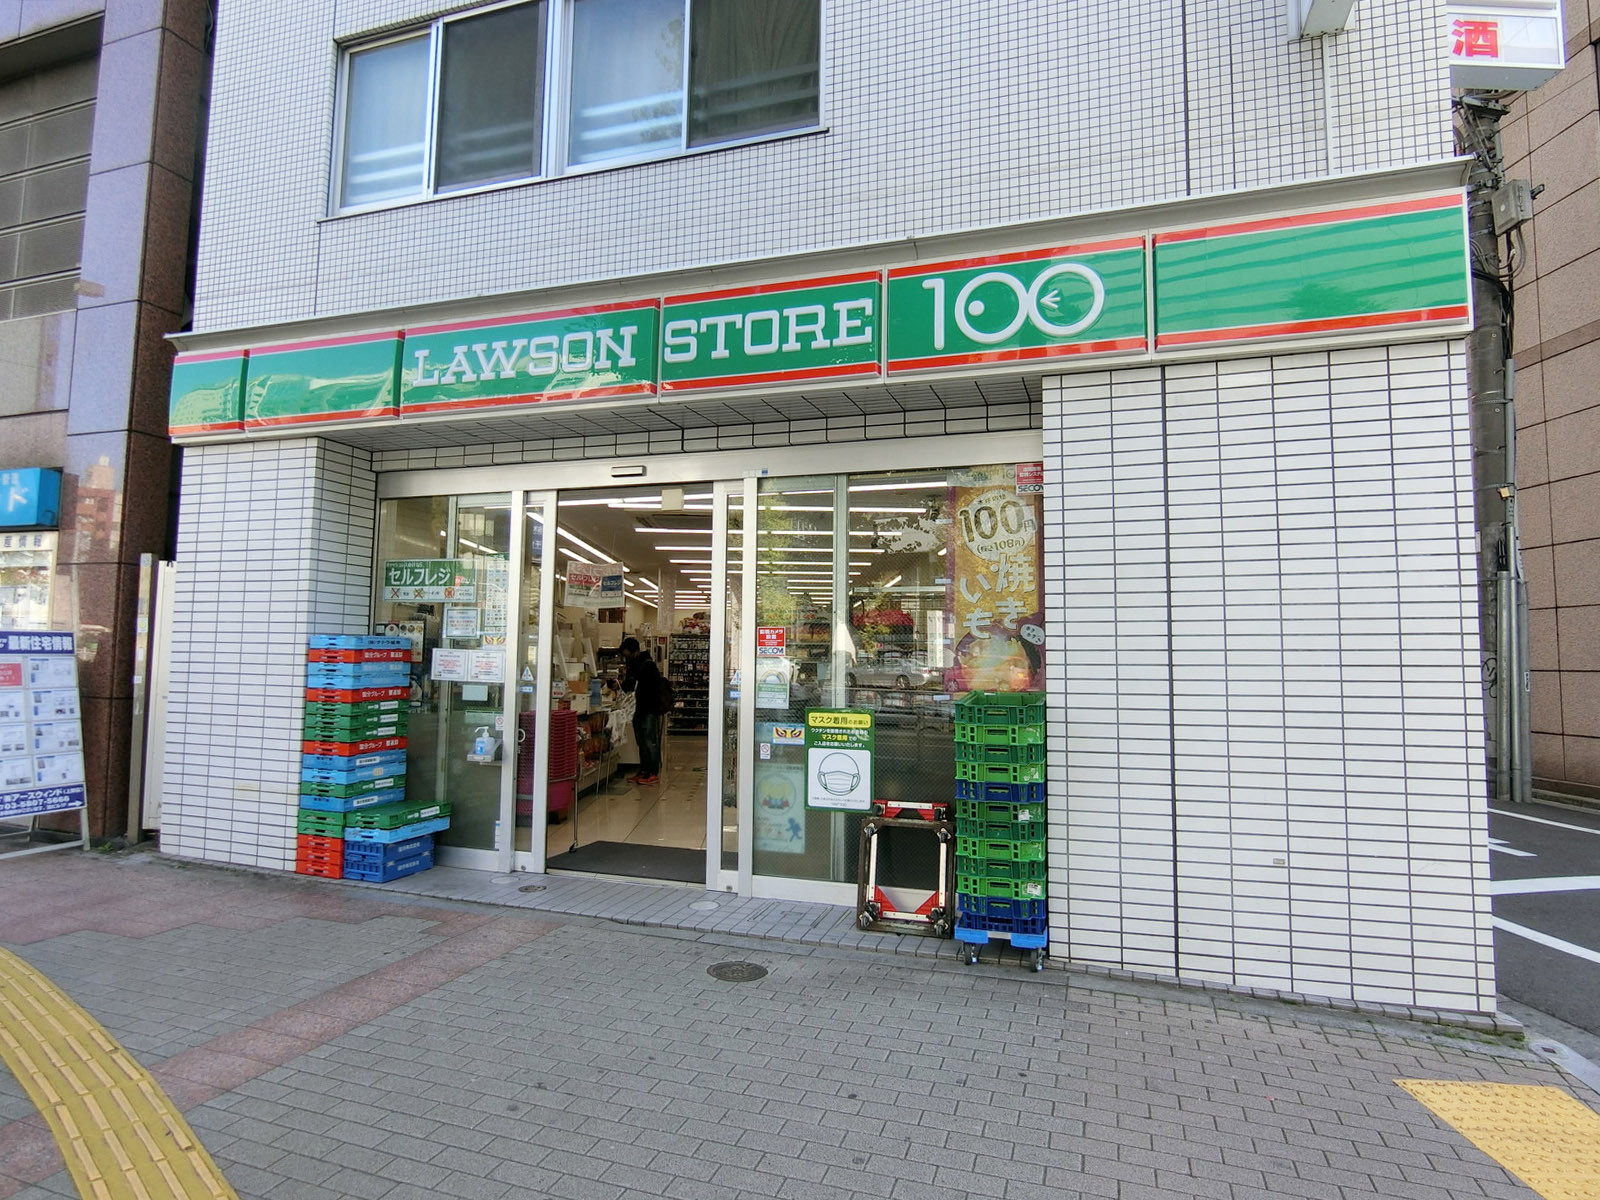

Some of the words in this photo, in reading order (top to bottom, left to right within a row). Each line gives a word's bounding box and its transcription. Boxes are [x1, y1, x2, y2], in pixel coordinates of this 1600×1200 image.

[1451, 19, 1499, 58] 酒
[412, 325, 638, 388] LAWSON
[663, 297, 873, 363] STORE
[922, 263, 1105, 350] 100
[389, 567, 451, 585] セルフレジ
[811, 715, 869, 726] マスク着用のお願い
